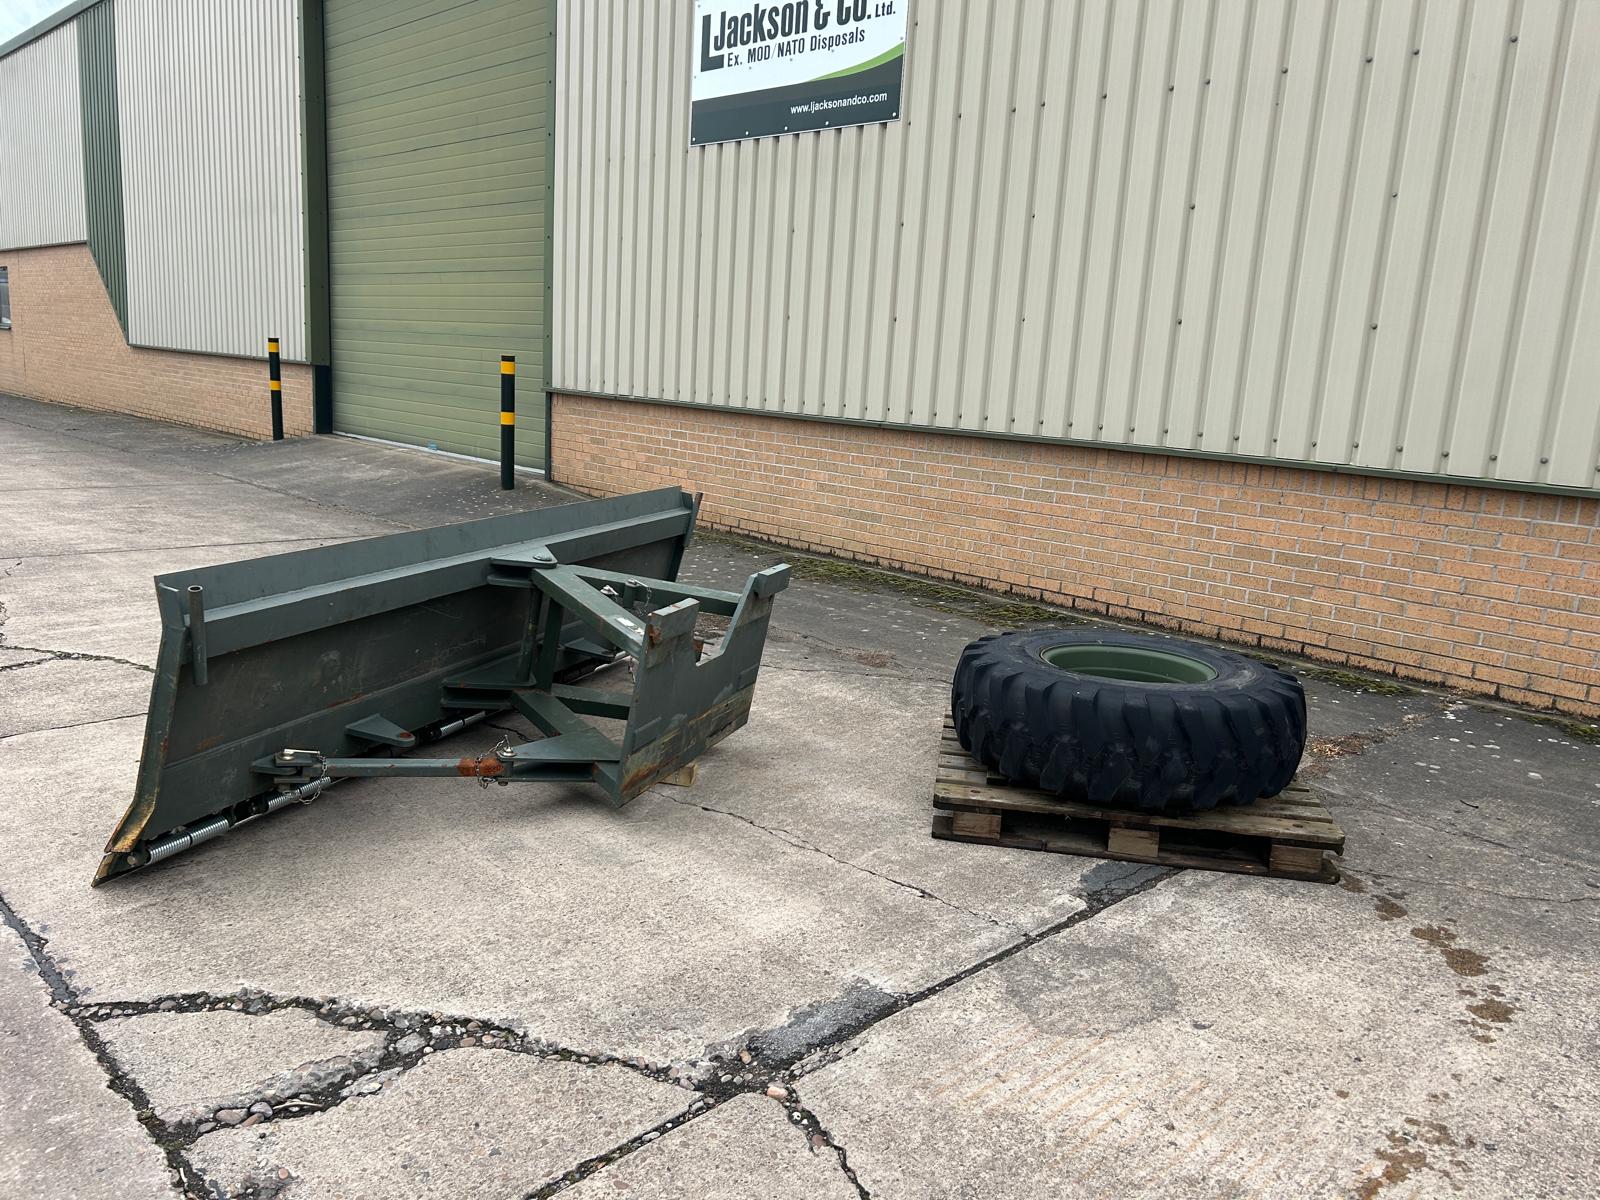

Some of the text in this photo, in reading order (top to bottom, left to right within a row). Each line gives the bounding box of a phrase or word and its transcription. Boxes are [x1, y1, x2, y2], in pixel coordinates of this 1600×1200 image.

[814, 0, 831, 30] &
[875, 1, 896, 18] Ltd.
[727, 27, 865, 67] Ex. MOD/NATO Disposals
[790, 92, 888, 114] www.ljacksonandco.com
